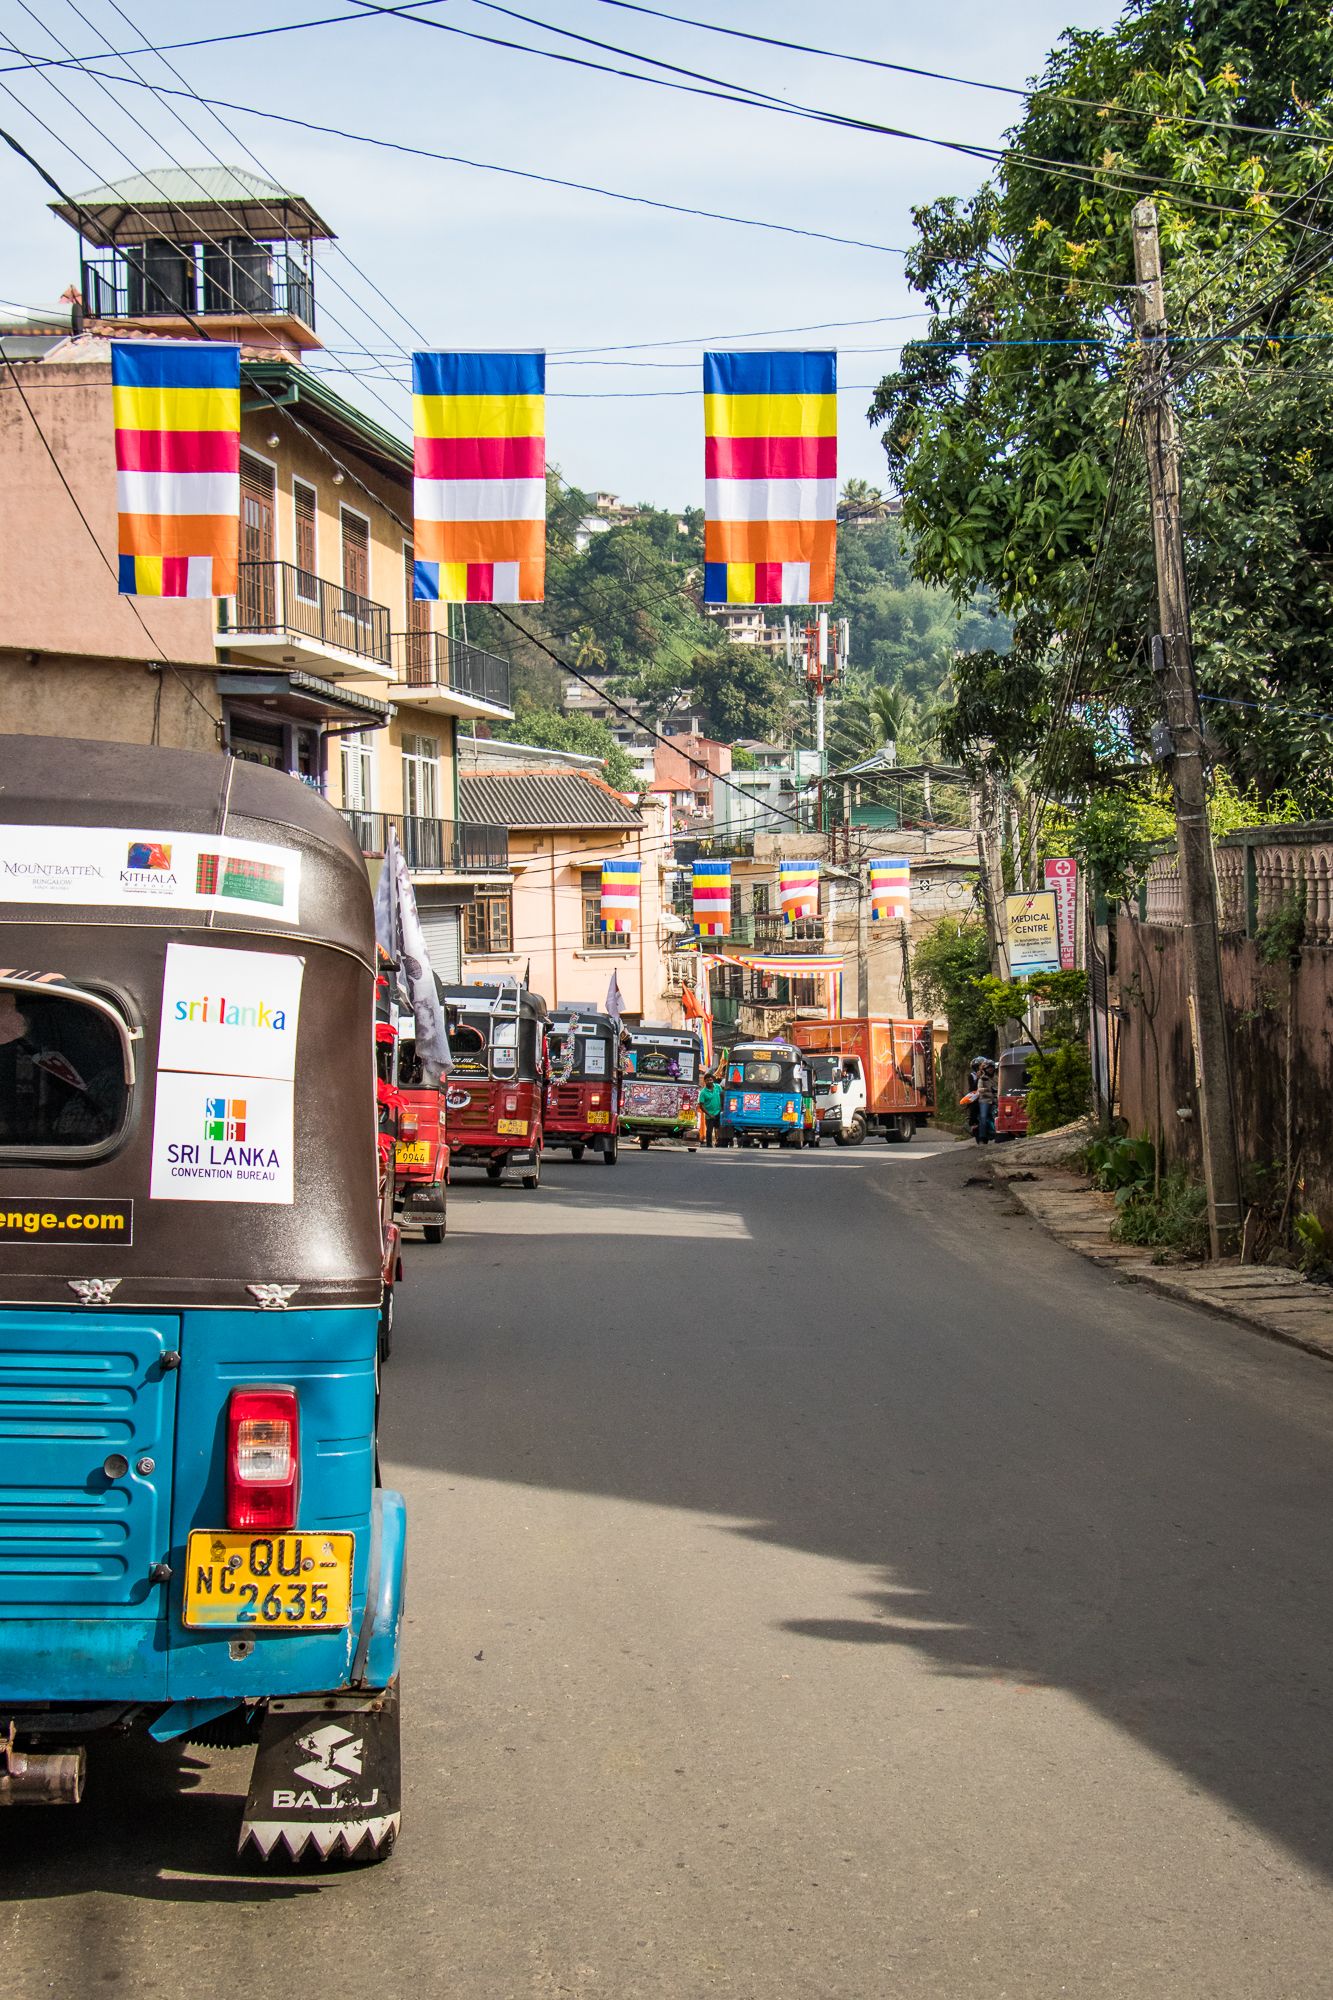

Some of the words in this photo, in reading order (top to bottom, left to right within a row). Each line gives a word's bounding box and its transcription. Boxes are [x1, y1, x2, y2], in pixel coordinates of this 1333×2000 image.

[3, 860, 104, 878] MOUNTBATTEN
[120, 870, 177, 884] KITHALA
[1011, 913, 1051, 923] MEDICAL
[1015, 924, 1049, 934] CENTRE
[175, 996, 209, 1022] sri
[219, 997, 286, 1030] lanka
[167, 1143, 199, 1164] SRI
[210, 1146, 280, 1168] LANKA
[402, 1152, 425, 1162] 9944
[171, 1167, 233, 1179] CONVENTION
[236, 1170, 276, 1181] BUREAU
[249, 1538, 303, 1577] QU
[196, 1566, 236, 1594] NC
[236, 1583, 329, 1622] 2635
